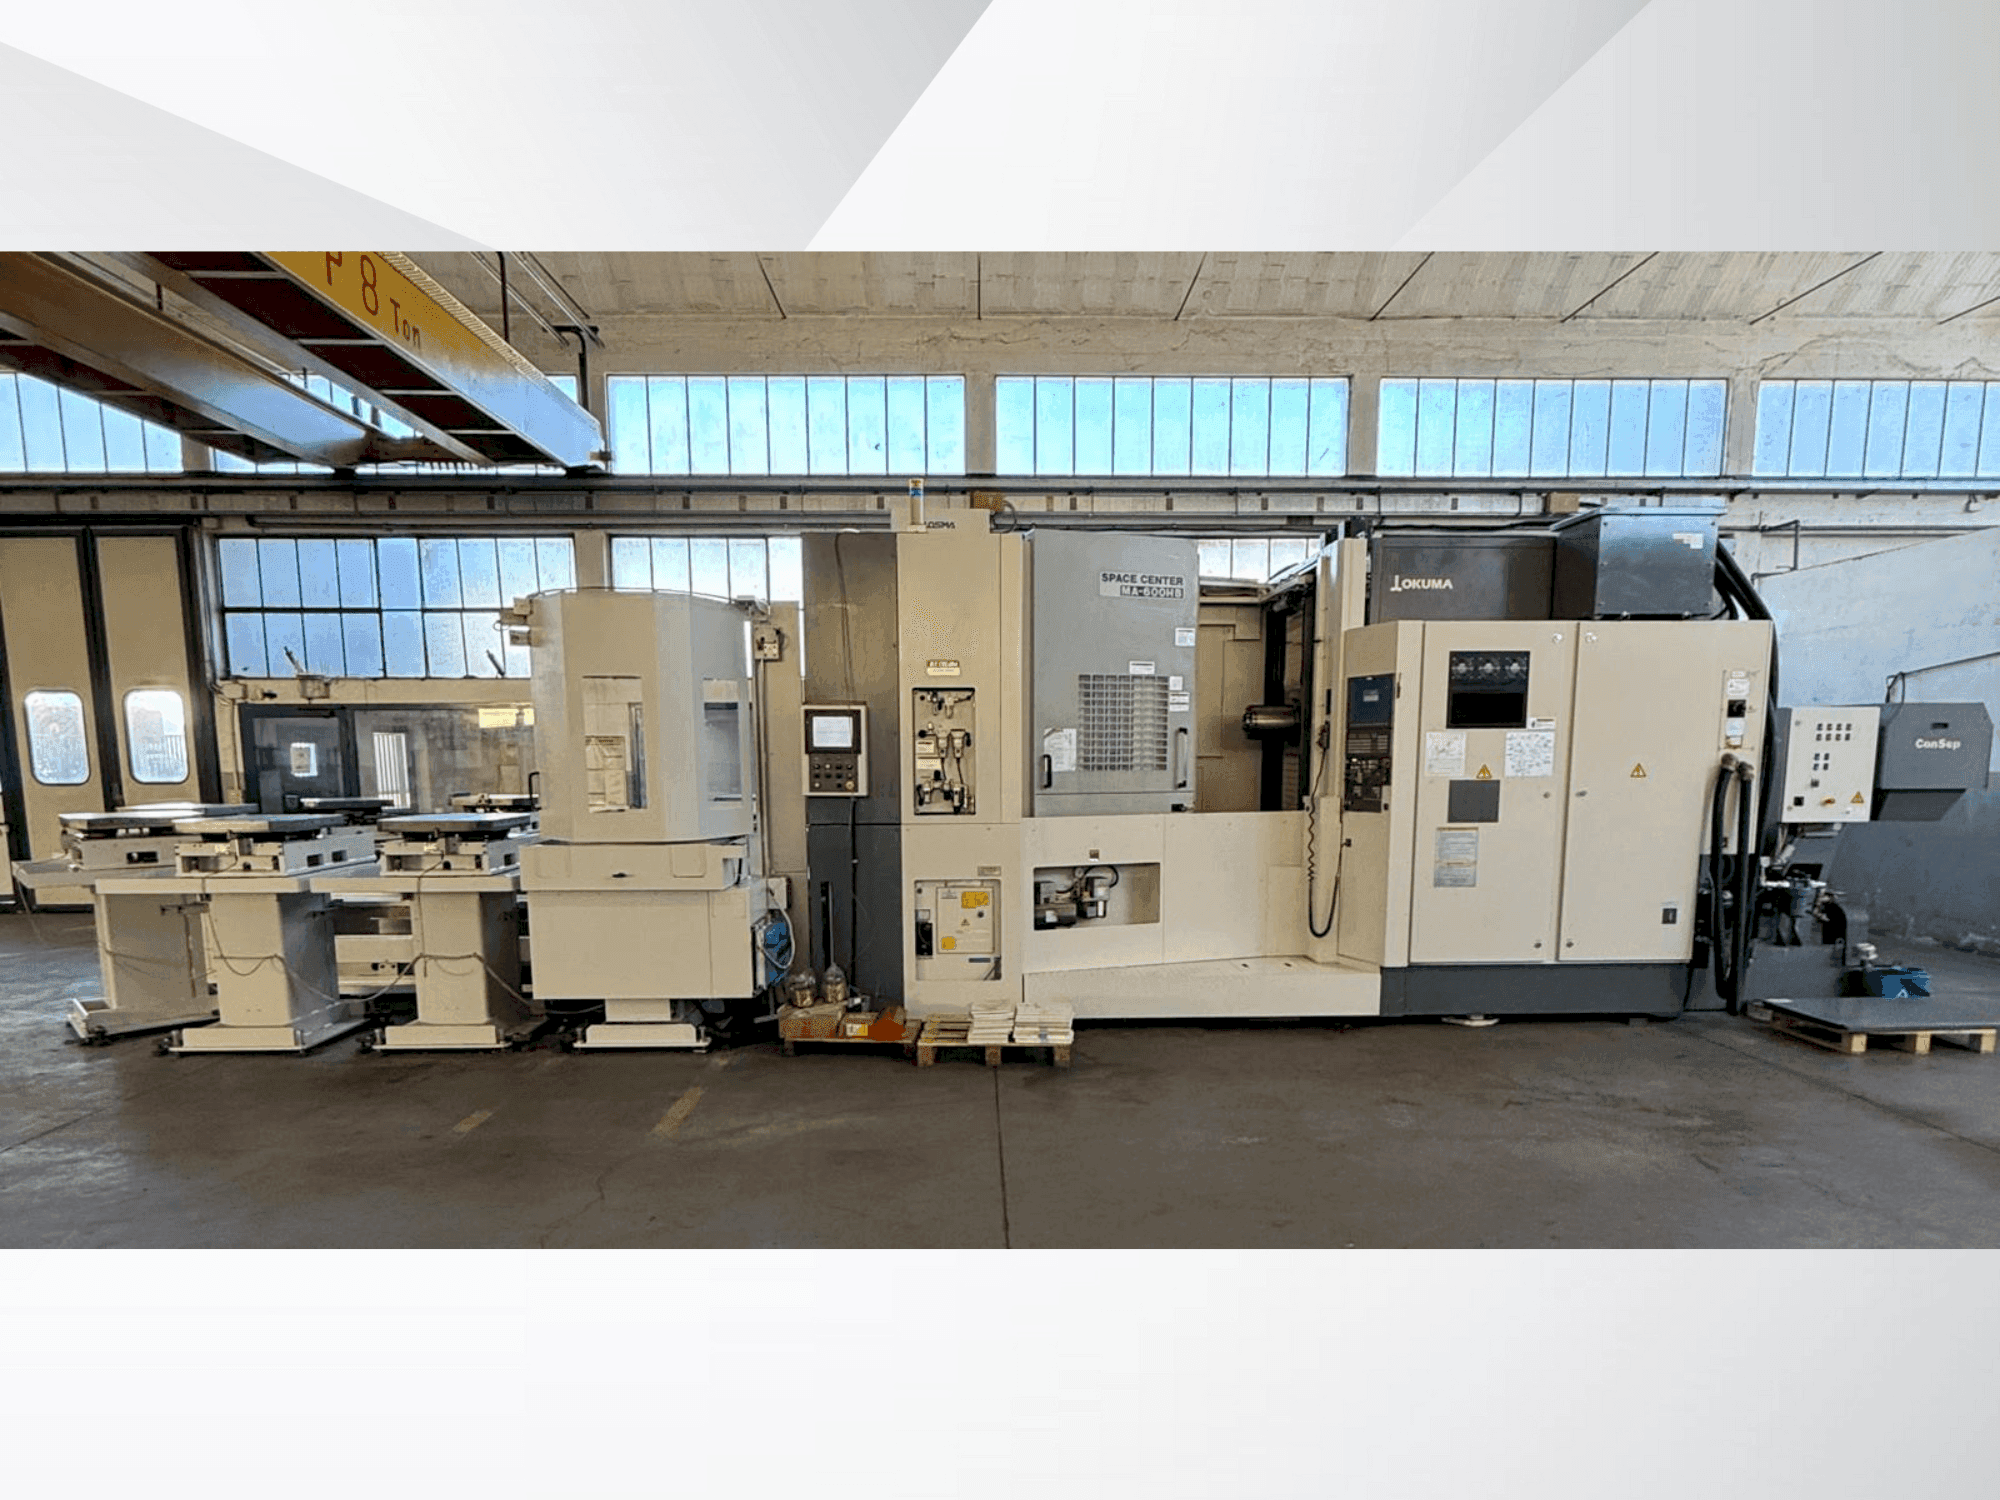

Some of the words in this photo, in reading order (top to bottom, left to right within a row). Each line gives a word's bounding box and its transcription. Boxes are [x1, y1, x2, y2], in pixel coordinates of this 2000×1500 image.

[359, 254, 379, 316] 8
[389, 297, 421, 349] Ton
[1101, 573, 1138, 584] SPACE
[1140, 574, 1184, 586] CENTER
[1400, 578, 1454, 590] OKUMA
[1121, 586, 1183, 598] MA-600HB
[1915, 738, 1961, 750] ConSep
